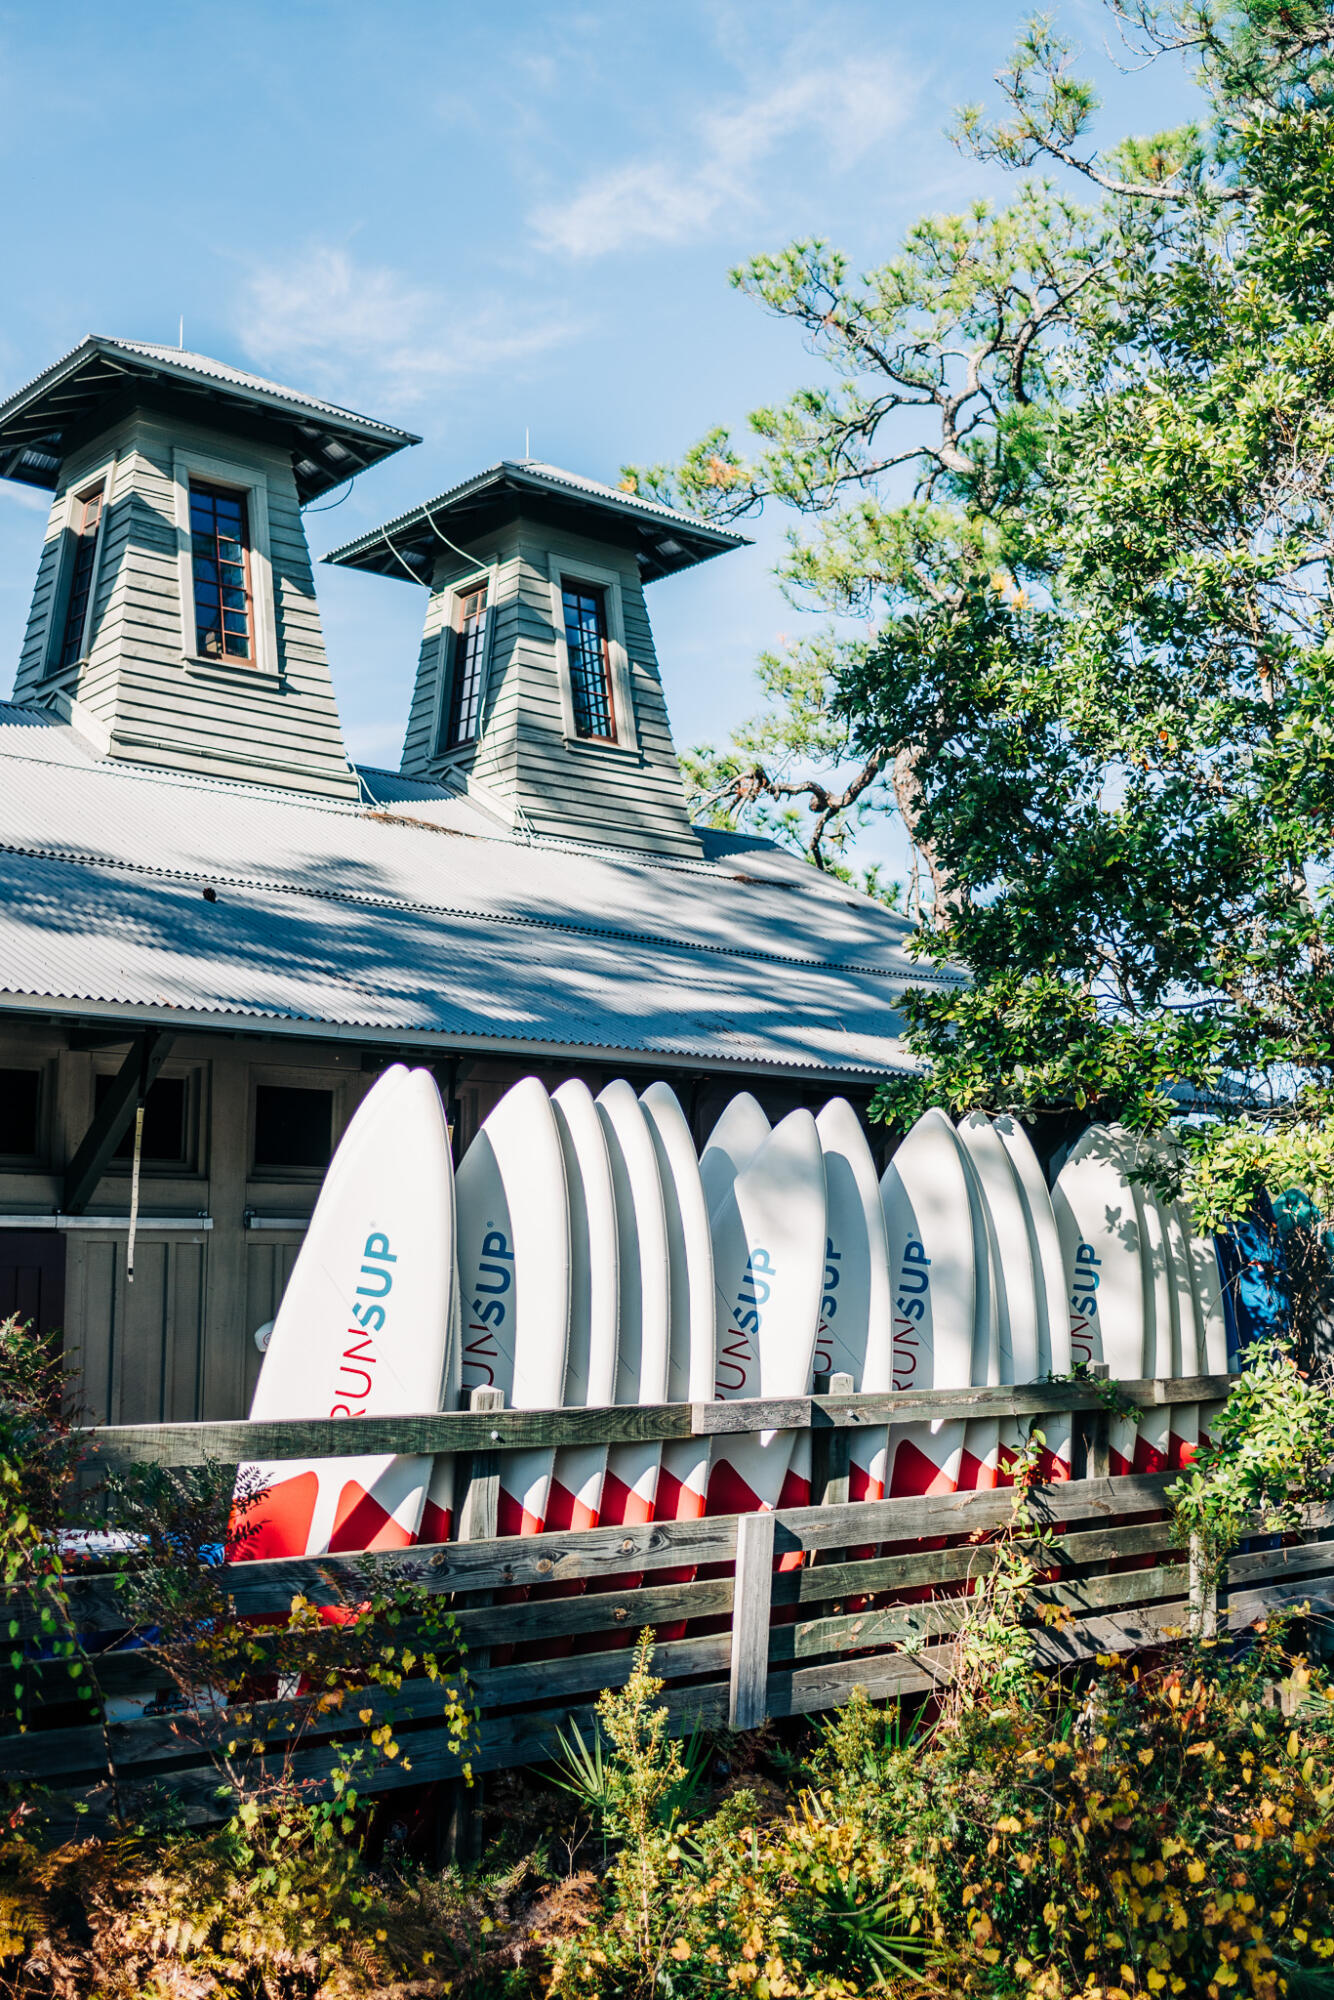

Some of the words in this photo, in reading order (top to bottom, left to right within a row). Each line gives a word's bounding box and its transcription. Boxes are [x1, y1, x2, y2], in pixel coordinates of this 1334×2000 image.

[462, 1231, 514, 1389] UNSUP
[714, 1248, 776, 1400] UNSUP
[1070, 1243, 1101, 1362] UNSUP
